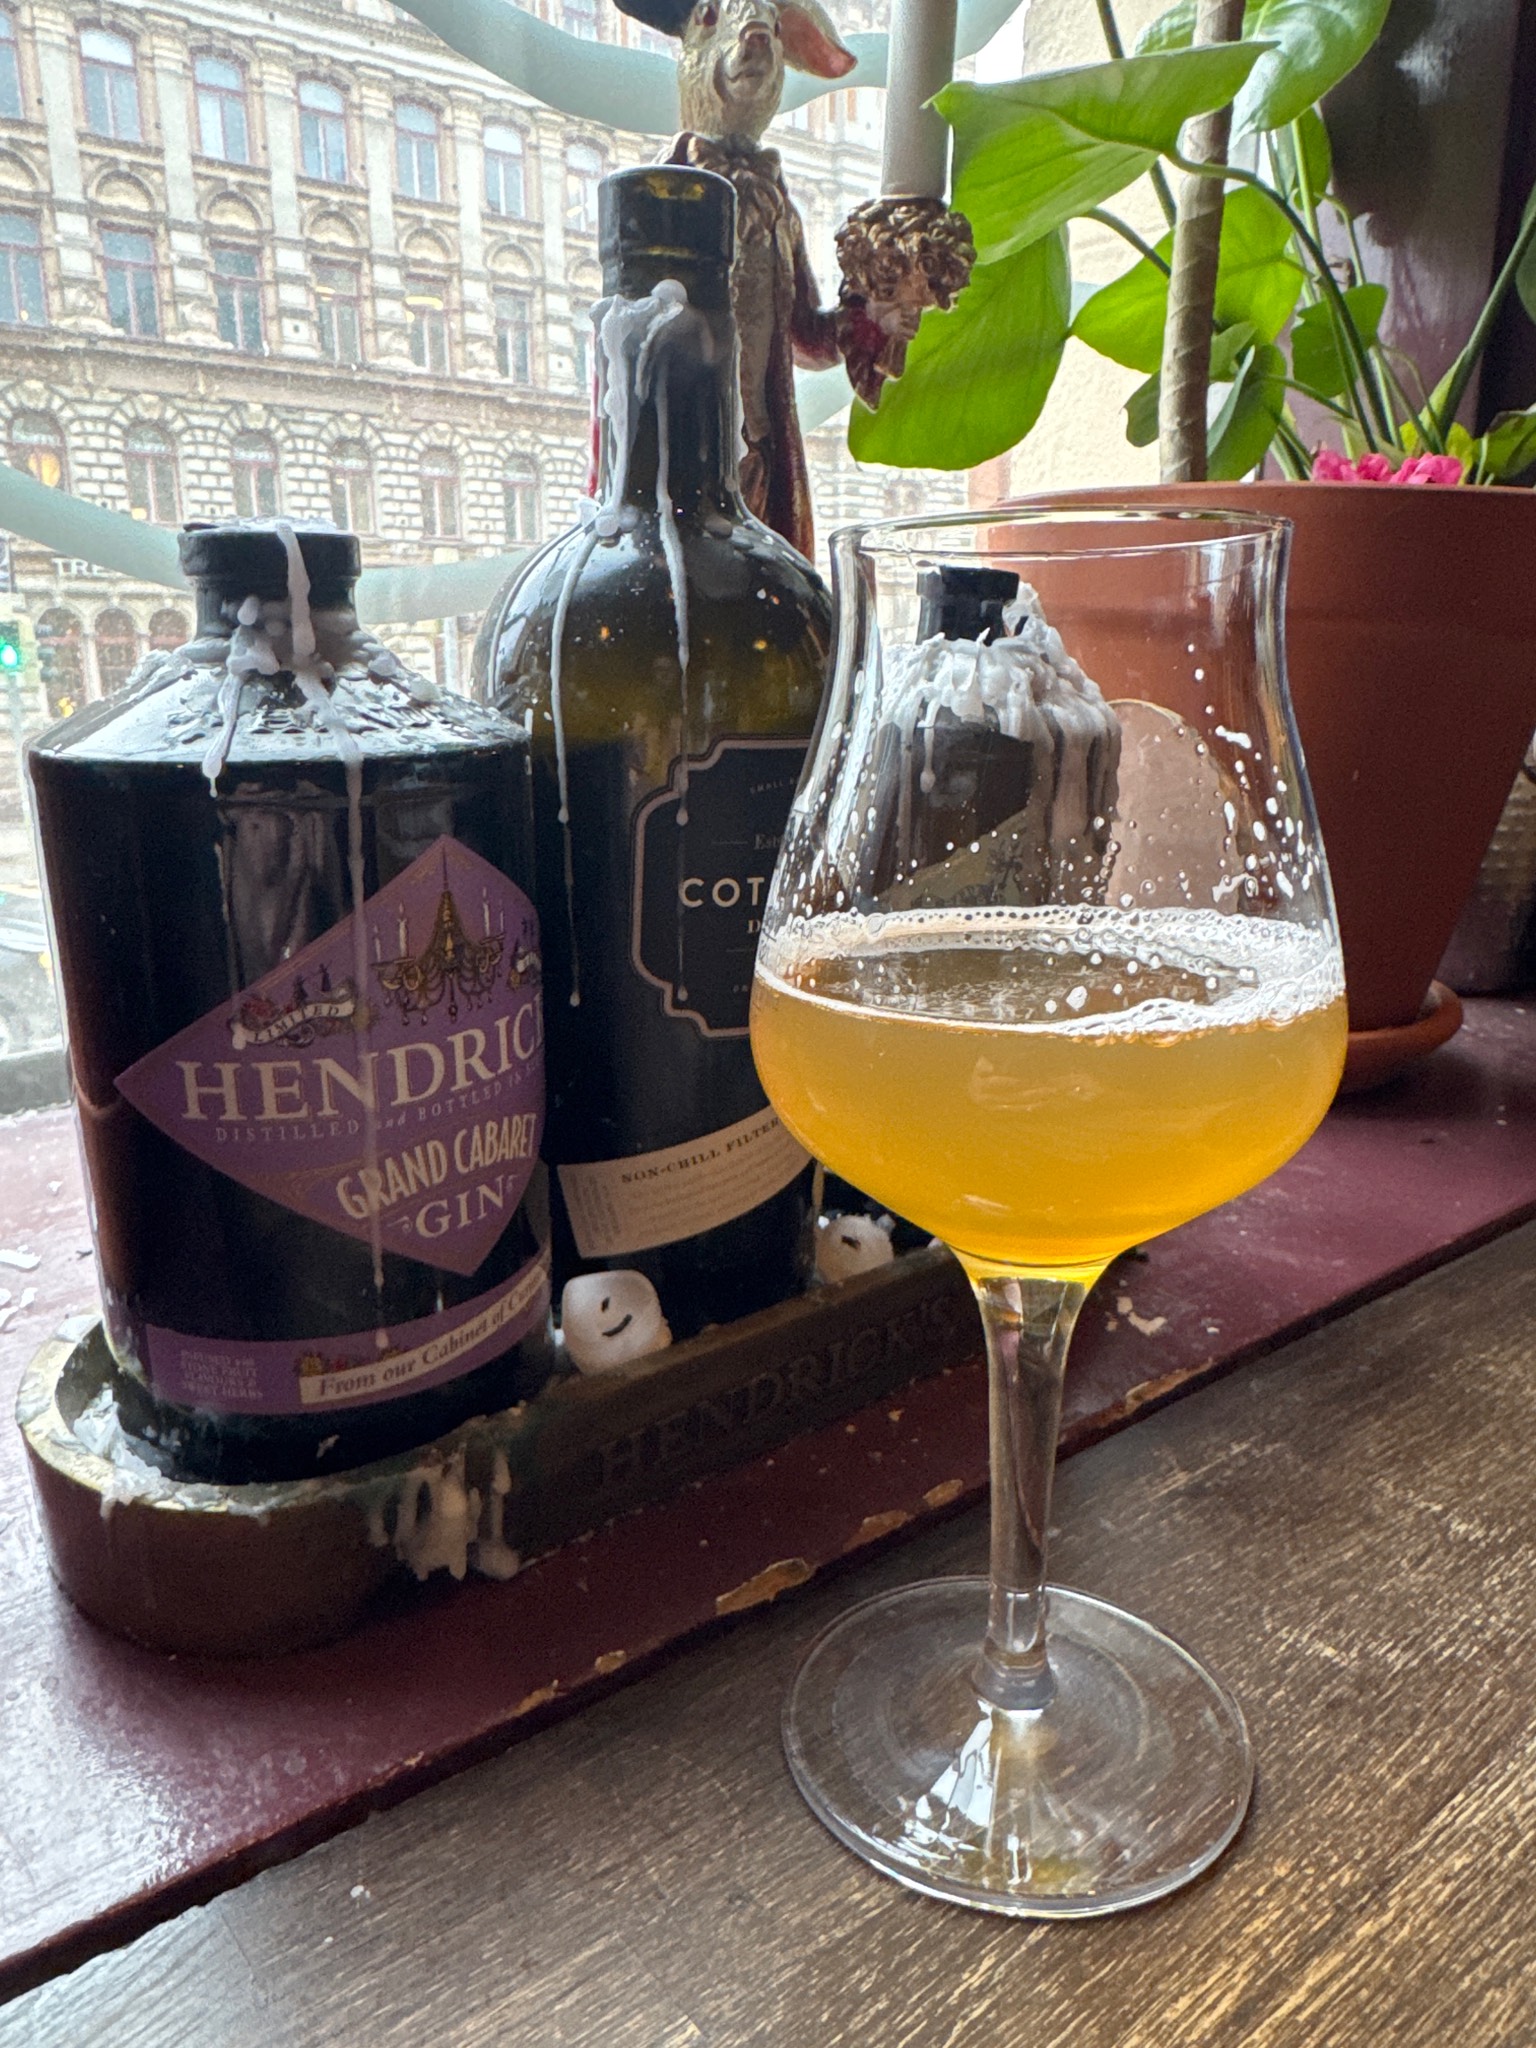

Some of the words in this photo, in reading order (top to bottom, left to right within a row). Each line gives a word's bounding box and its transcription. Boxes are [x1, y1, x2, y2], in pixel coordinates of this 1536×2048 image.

[252, 1003, 339, 1041] LIMITED
[215, 1118, 359, 1142] DISTILLED
[418, 1079, 504, 1121] BOTTLED
[336, 1139, 448, 1220] GRAND
[453, 1112, 538, 1175] CABARET
[620, 1147, 721, 1184] NON-CHILL
[415, 1174, 507, 1239] GIN
[319, 1373, 377, 1397] From
[382, 1359, 416, 1382] our
[422, 1314, 488, 1364] Cabinet
